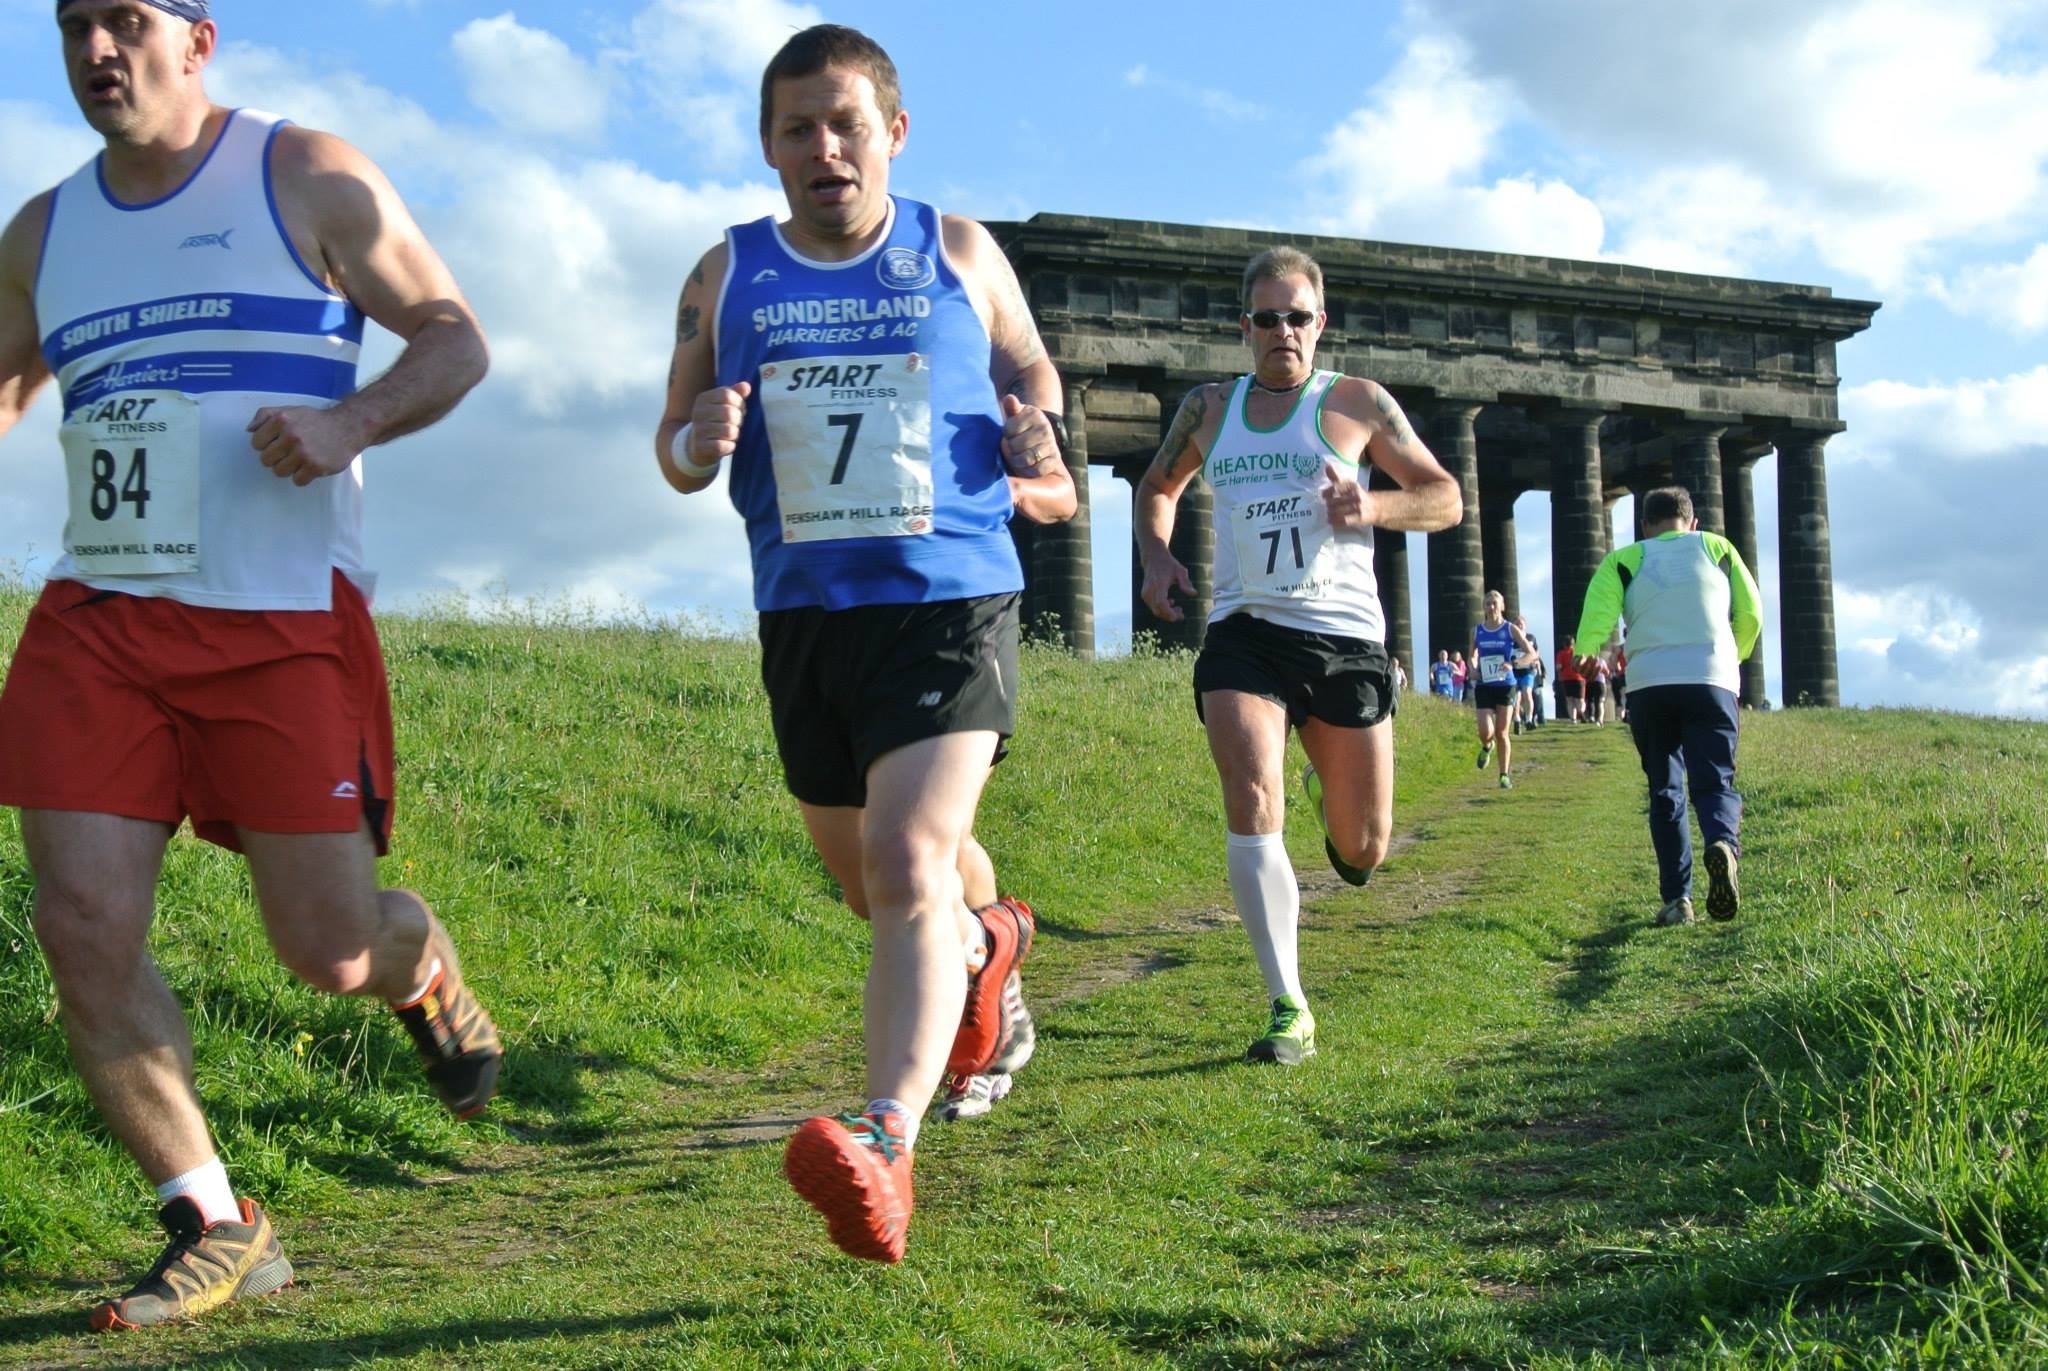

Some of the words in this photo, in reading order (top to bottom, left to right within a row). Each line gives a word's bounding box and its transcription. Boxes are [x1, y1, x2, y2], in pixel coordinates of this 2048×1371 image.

[62, 311, 131, 350] SOUTH
[137, 299, 233, 327] SHIELDS
[752, 295, 931, 332] SUNDERLAND
[767, 326, 866, 347] HARRIERS
[869, 324, 886, 340] &
[890, 322, 918, 337] AC
[103, 361, 179, 390] Harriers
[786, 363, 883, 391] START
[831, 387, 897, 399] FITNESS
[86, 398, 156, 422] TART
[108, 422, 167, 433] FITNESS
[826, 412, 864, 486] 7
[1213, 452, 1288, 477] HEATON
[91, 447, 151, 521] 84
[1229, 472, 1268, 487] Harriers
[785, 509, 845, 525] PENSHAW
[849, 507, 885, 519] HILL
[890, 505, 931, 517] RACE
[1245, 496, 1301, 520] START
[1272, 509, 1313, 521] FITNESS
[74, 545, 119, 556] ENSHAW
[122, 544, 148, 555] HILL
[153, 543, 197, 555] RACE
[1259, 526, 1304, 575] 71
